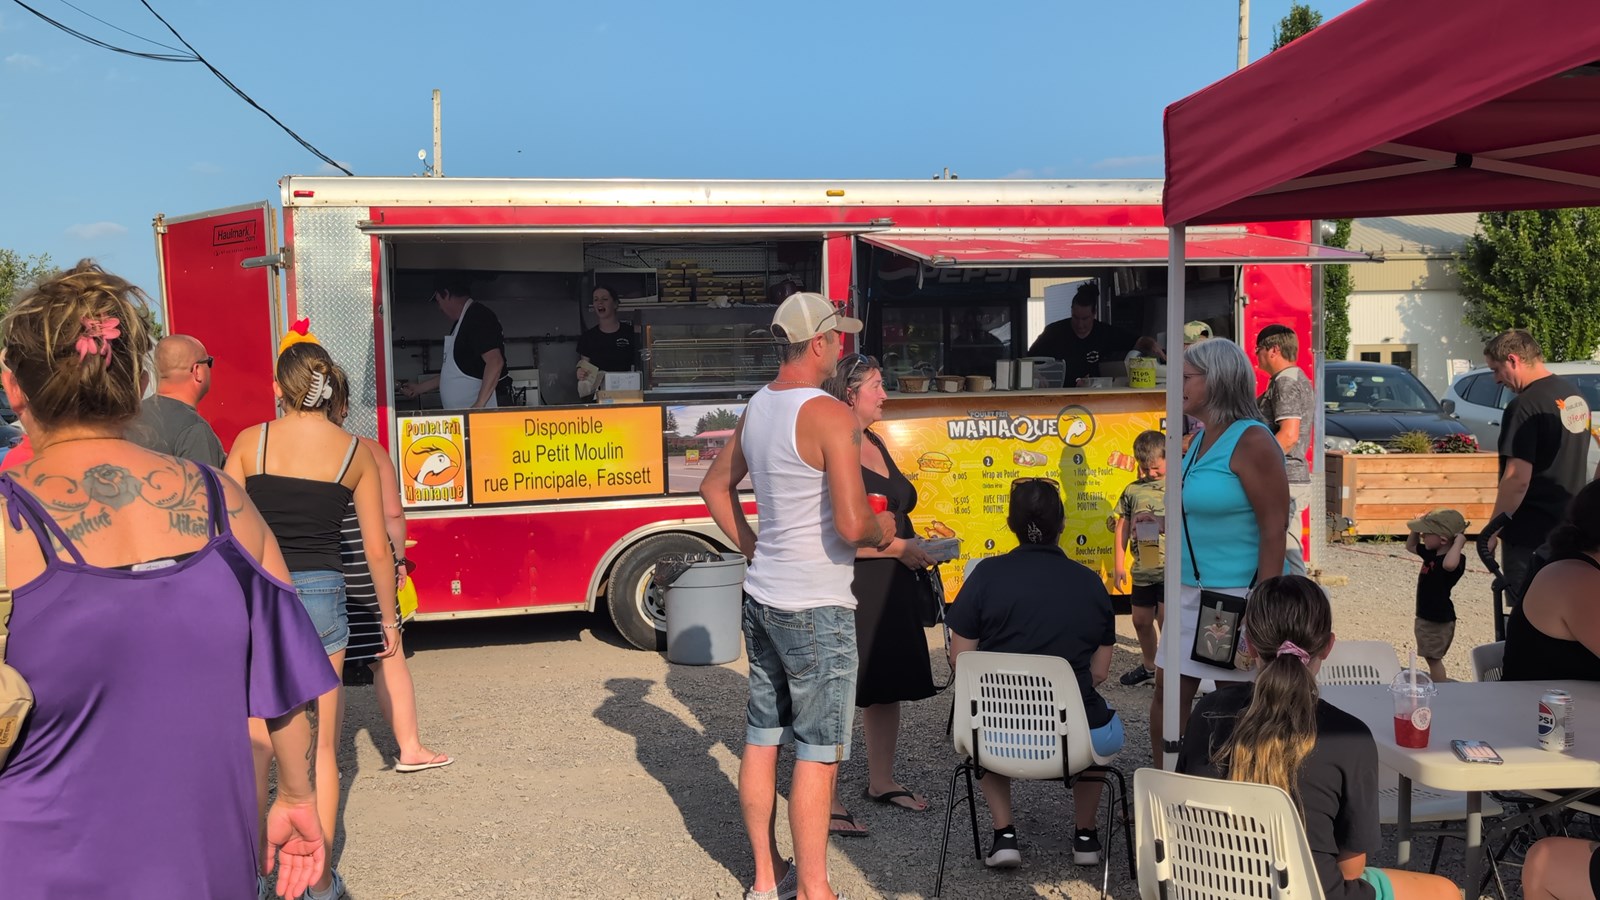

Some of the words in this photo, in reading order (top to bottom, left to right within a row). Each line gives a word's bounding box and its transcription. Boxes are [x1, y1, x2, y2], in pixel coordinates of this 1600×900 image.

[217, 226, 250, 240] Haulmark
[405, 420, 441, 437] Poulet
[524, 416, 603, 440] Disponible
[949, 416, 1059, 442] MANIAQUE
[512, 449, 531, 464] au
[536, 443, 570, 463] Petit
[574, 442, 624, 461] Moulin
[982, 470, 996, 480] Wrap
[1003, 469, 1020, 478] Poulet
[1097, 467, 1114, 476] Poulet
[484, 476, 509, 493] rue
[514, 470, 592, 493] Principale,
[597, 467, 652, 486] Fassett
[405, 485, 464, 501] Maniaque
[983, 494, 996, 503] AVEC
[1077, 491, 1089, 501] AVEC
[983, 504, 1004, 514] POUTINE
[1077, 502, 1098, 511] POUTINE
[1075, 546, 1096, 556] Bouchée
[1097, 546, 1113, 555] Poulet
